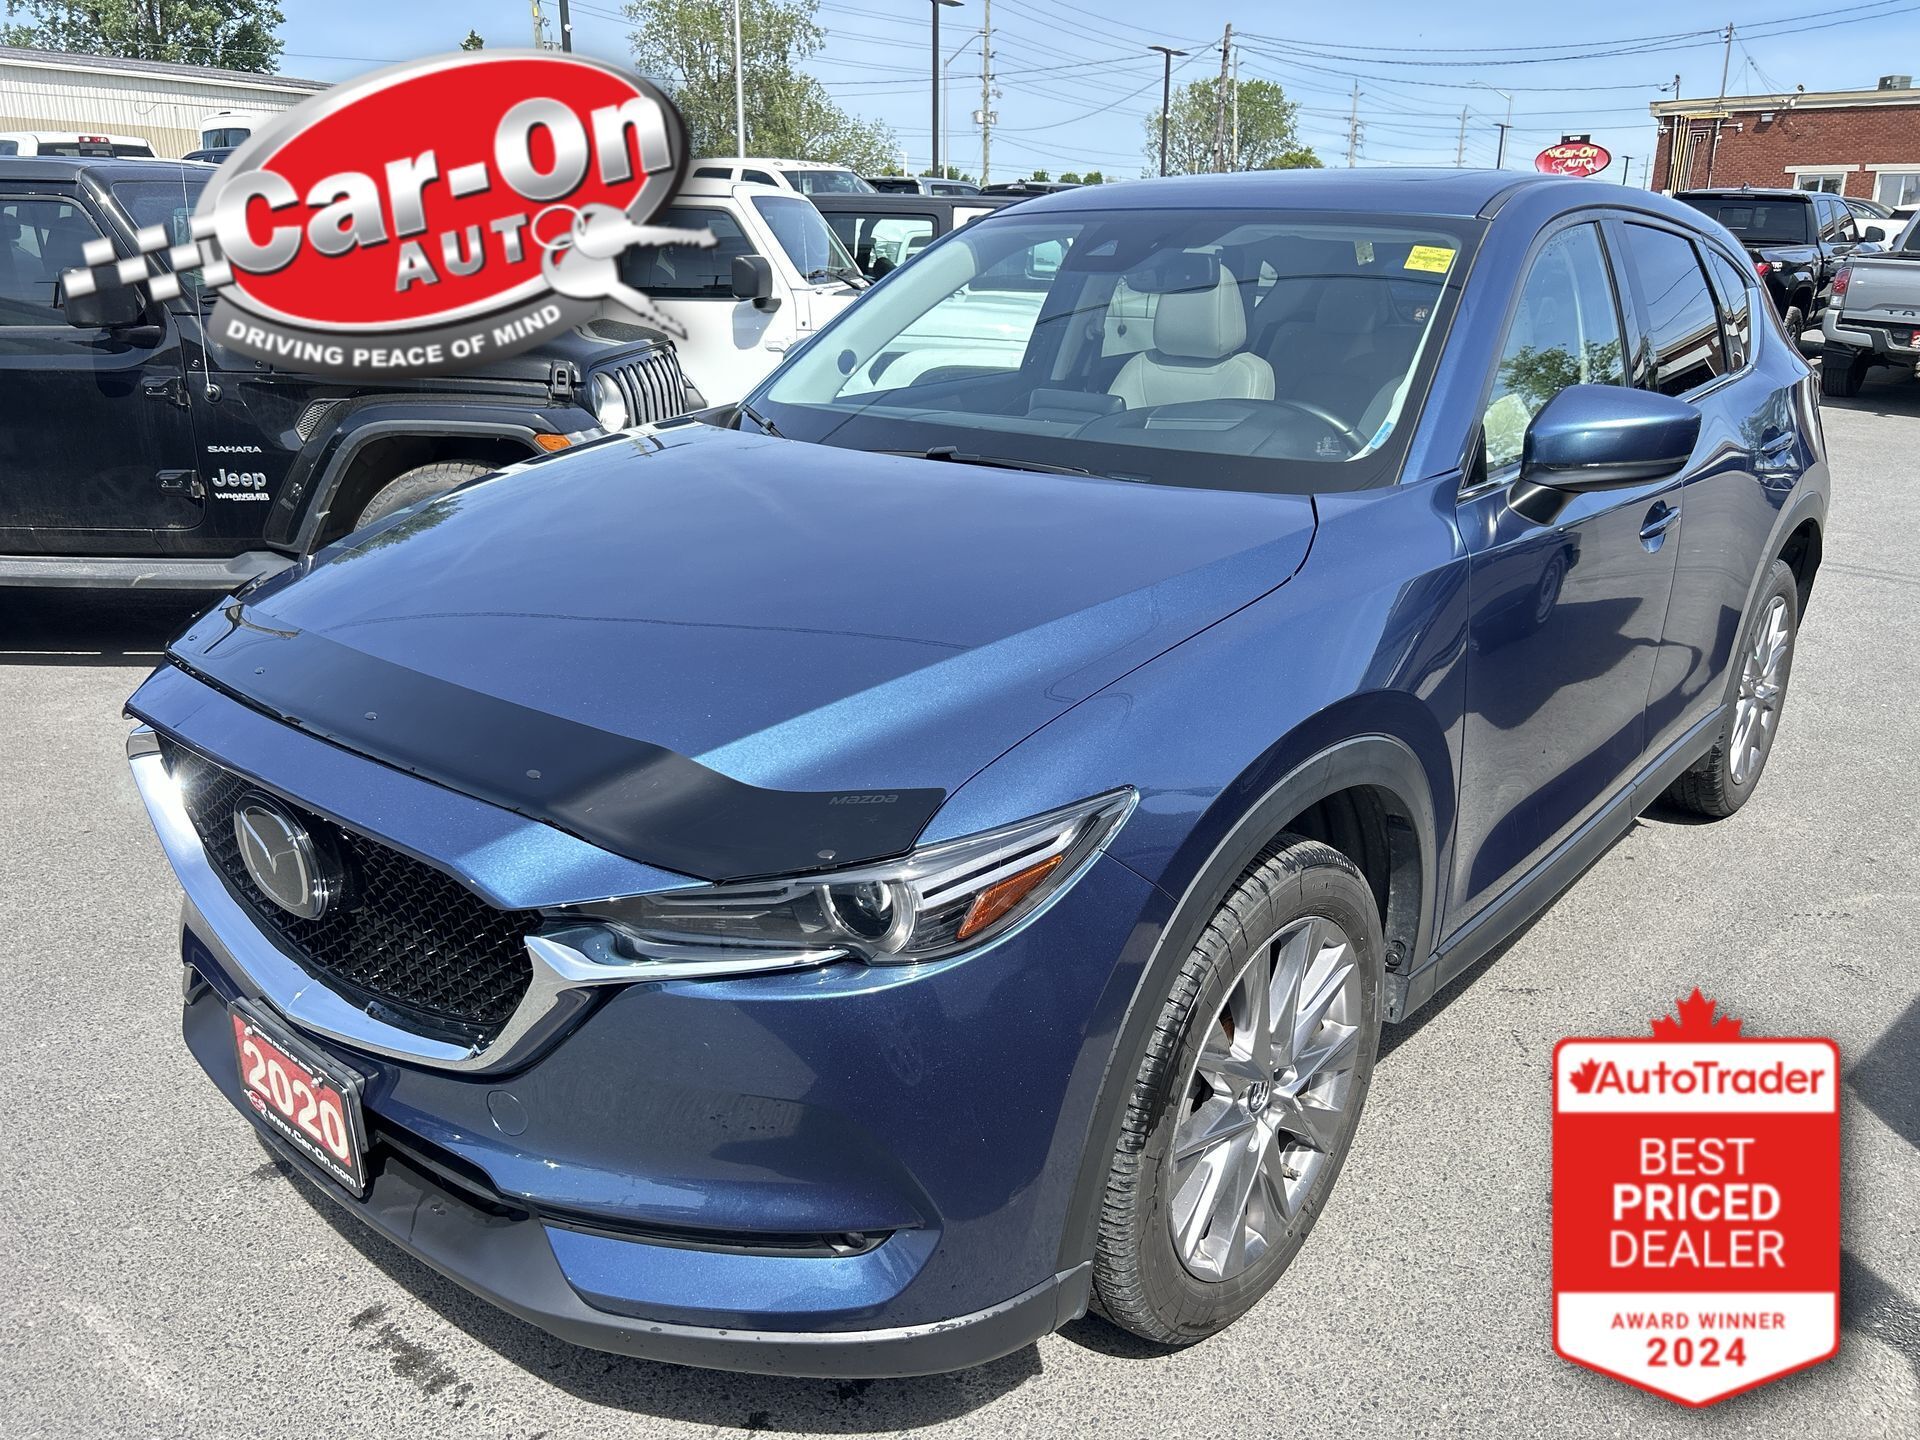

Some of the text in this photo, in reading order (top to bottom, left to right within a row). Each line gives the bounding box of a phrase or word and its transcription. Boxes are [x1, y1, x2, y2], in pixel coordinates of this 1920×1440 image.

[1557, 147, 1598, 158] Car-On
[207, 445, 262, 453] SAHARA
[212, 468, 267, 491] Jeep
[242, 1039, 349, 1160] 2020
[267, 1110, 357, 1188] www.Car-On.com
